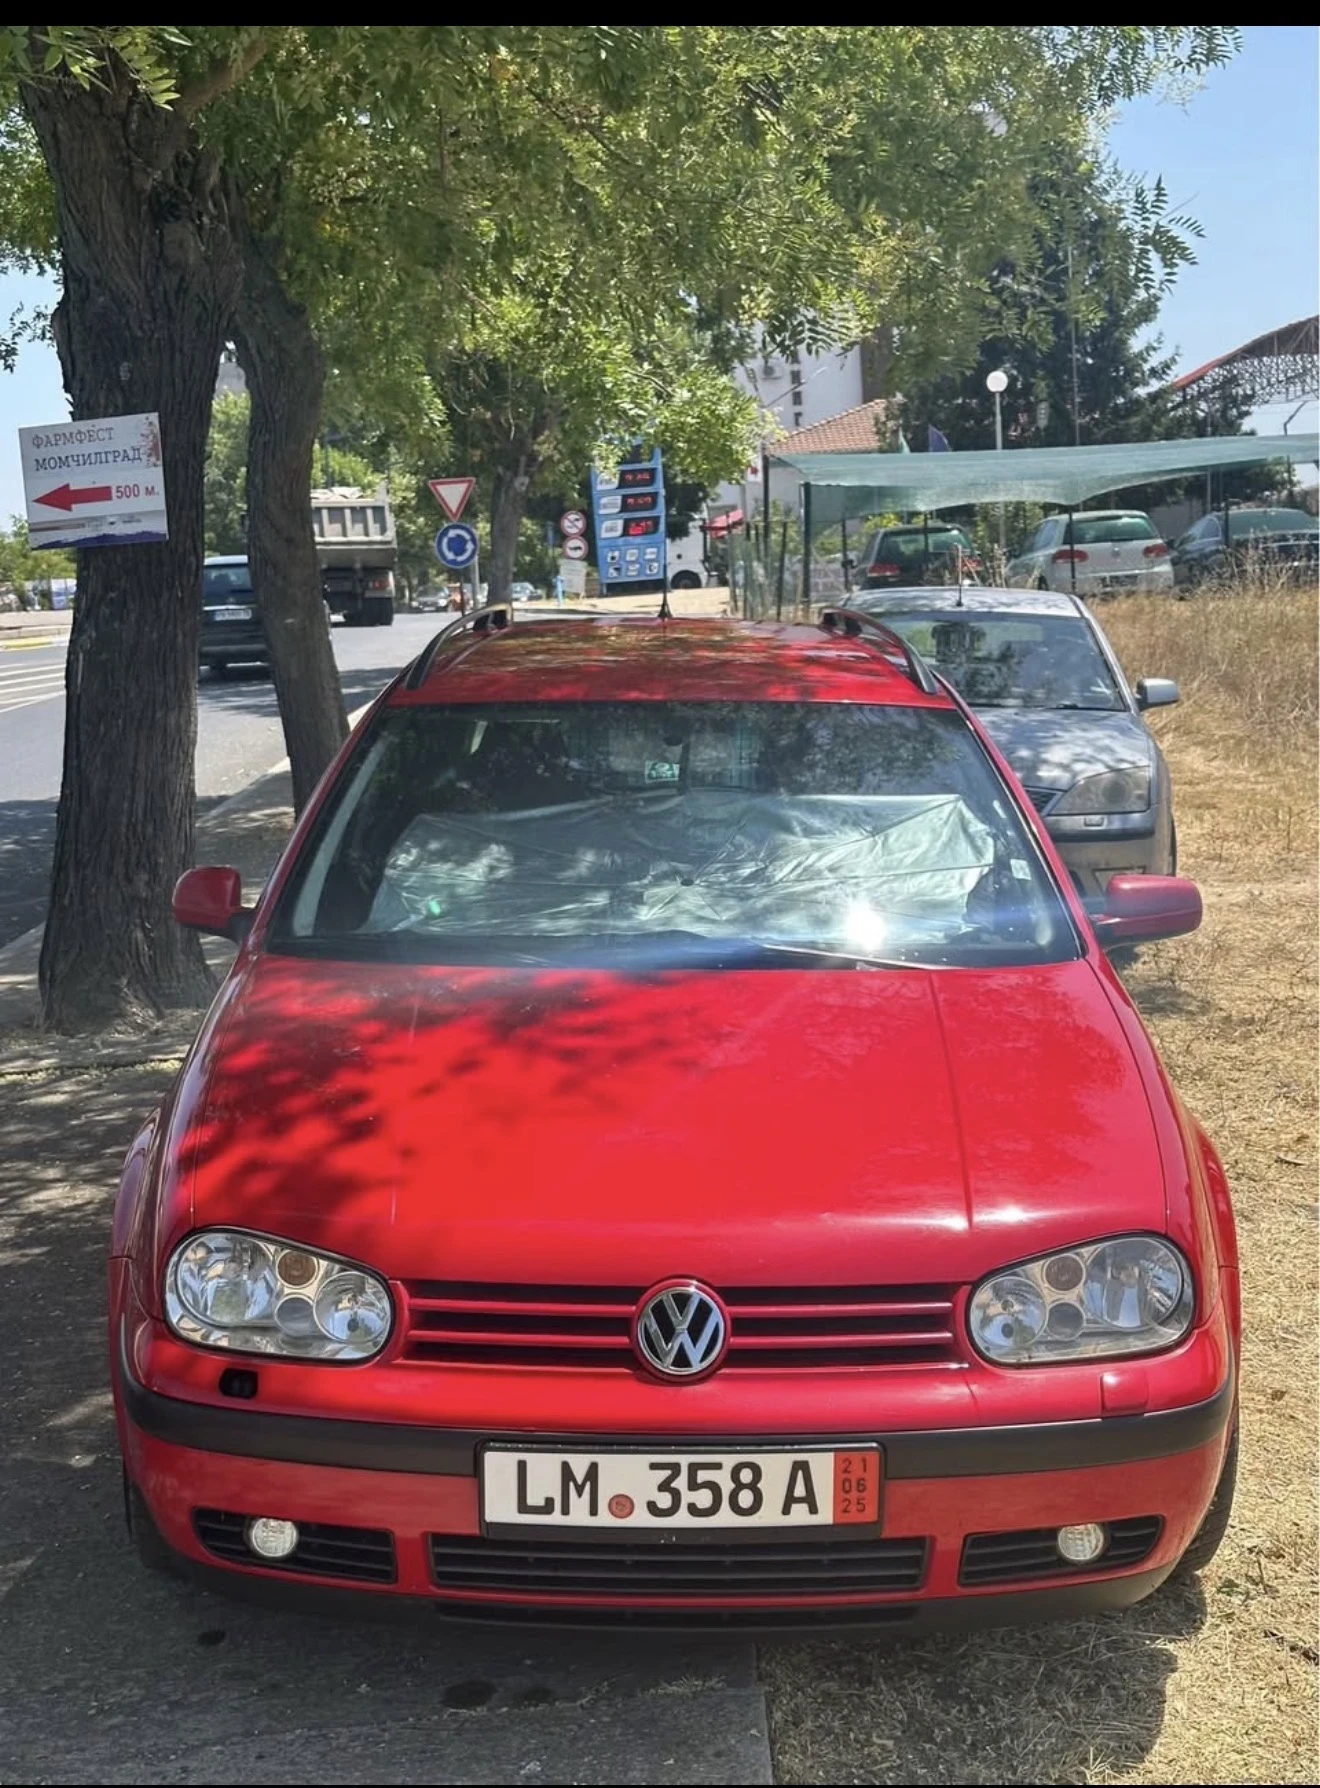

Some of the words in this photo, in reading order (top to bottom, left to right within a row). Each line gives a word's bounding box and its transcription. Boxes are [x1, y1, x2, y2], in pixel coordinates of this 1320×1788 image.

[32, 427, 114, 448] ФАРМФЕСТ
[35, 447, 142, 471] МОМЧИЛГРАД
[116, 484, 140, 499] 500
[841, 1457, 867, 1474] 21
[516, 1459, 599, 1517] LM
[646, 1461, 764, 1518] 358
[780, 1459, 819, 1516] A
[842, 1478, 867, 1494] 06
[841, 1497, 867, 1514] 25
